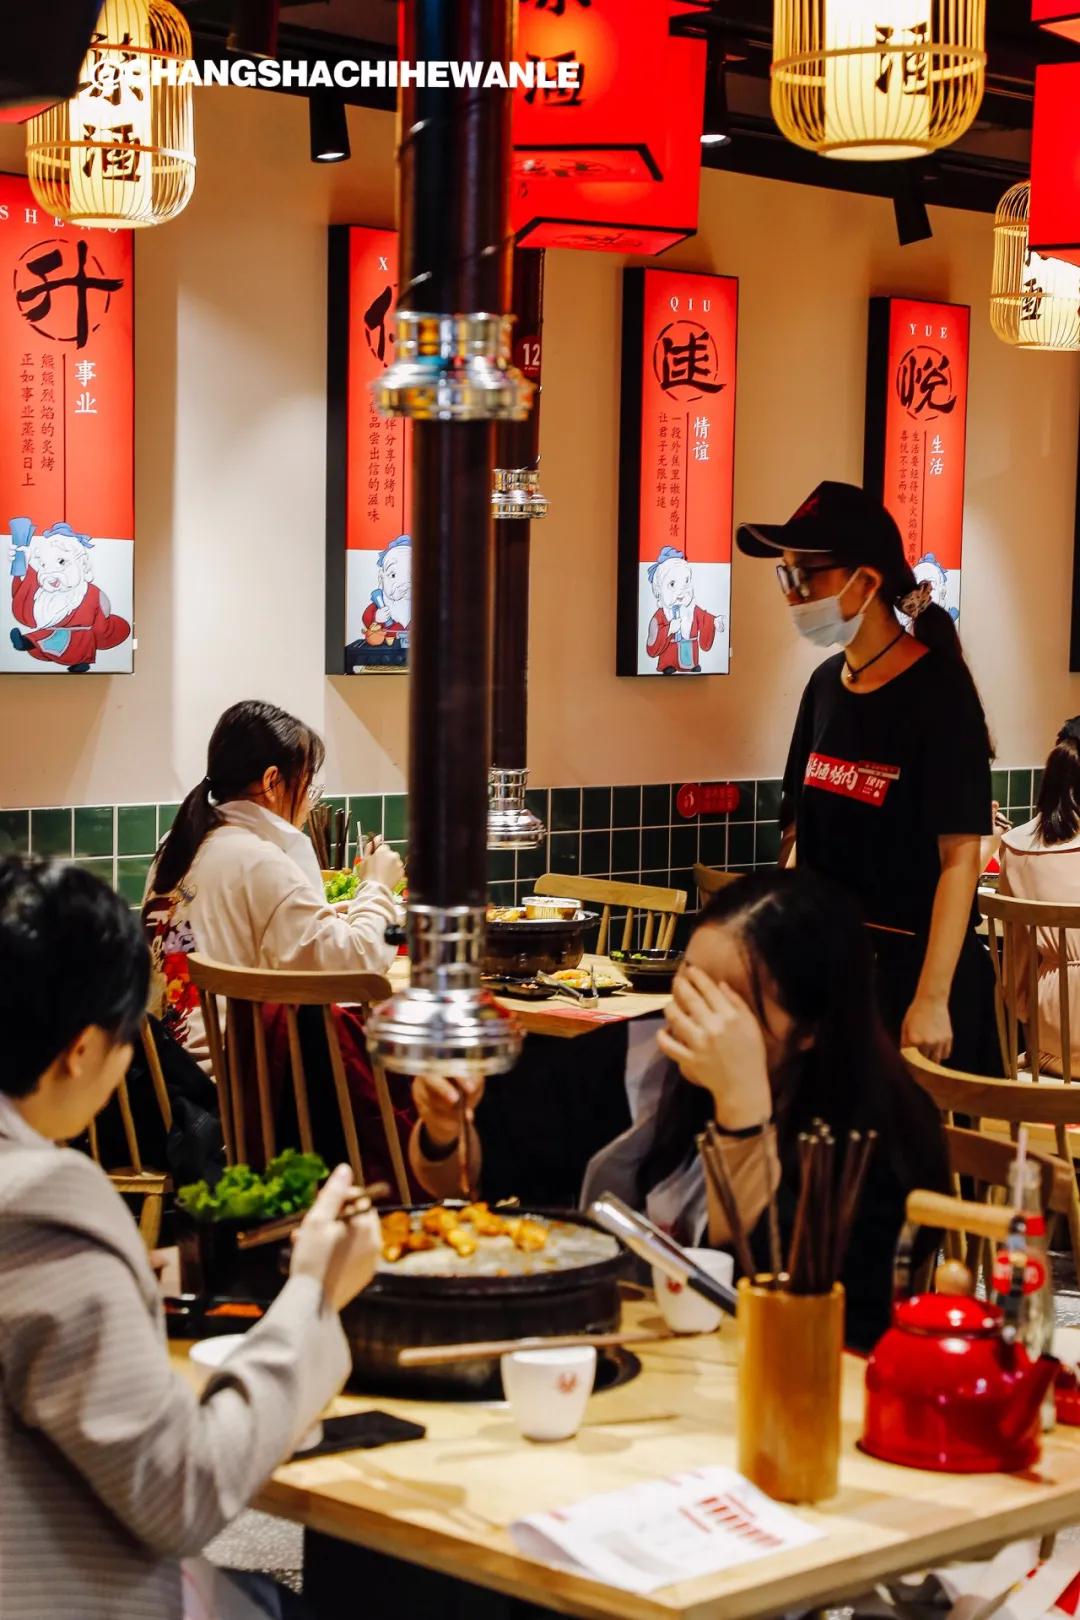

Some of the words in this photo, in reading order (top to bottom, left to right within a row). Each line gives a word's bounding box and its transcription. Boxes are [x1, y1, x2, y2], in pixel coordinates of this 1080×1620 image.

[16, 240, 125, 350] 升
[670, 297, 711, 313] QIU
[908, 323, 948, 339] YUE
[523, 343, 540, 366] 12
[74, 359, 98, 414] 事业
[20, 353, 36, 487] 正如事业蒸蒸日上
[40, 353, 55, 472] 熊熊烈焰的炙烤
[693, 416, 710, 461] 情谊
[929, 434, 944, 476] 生活
